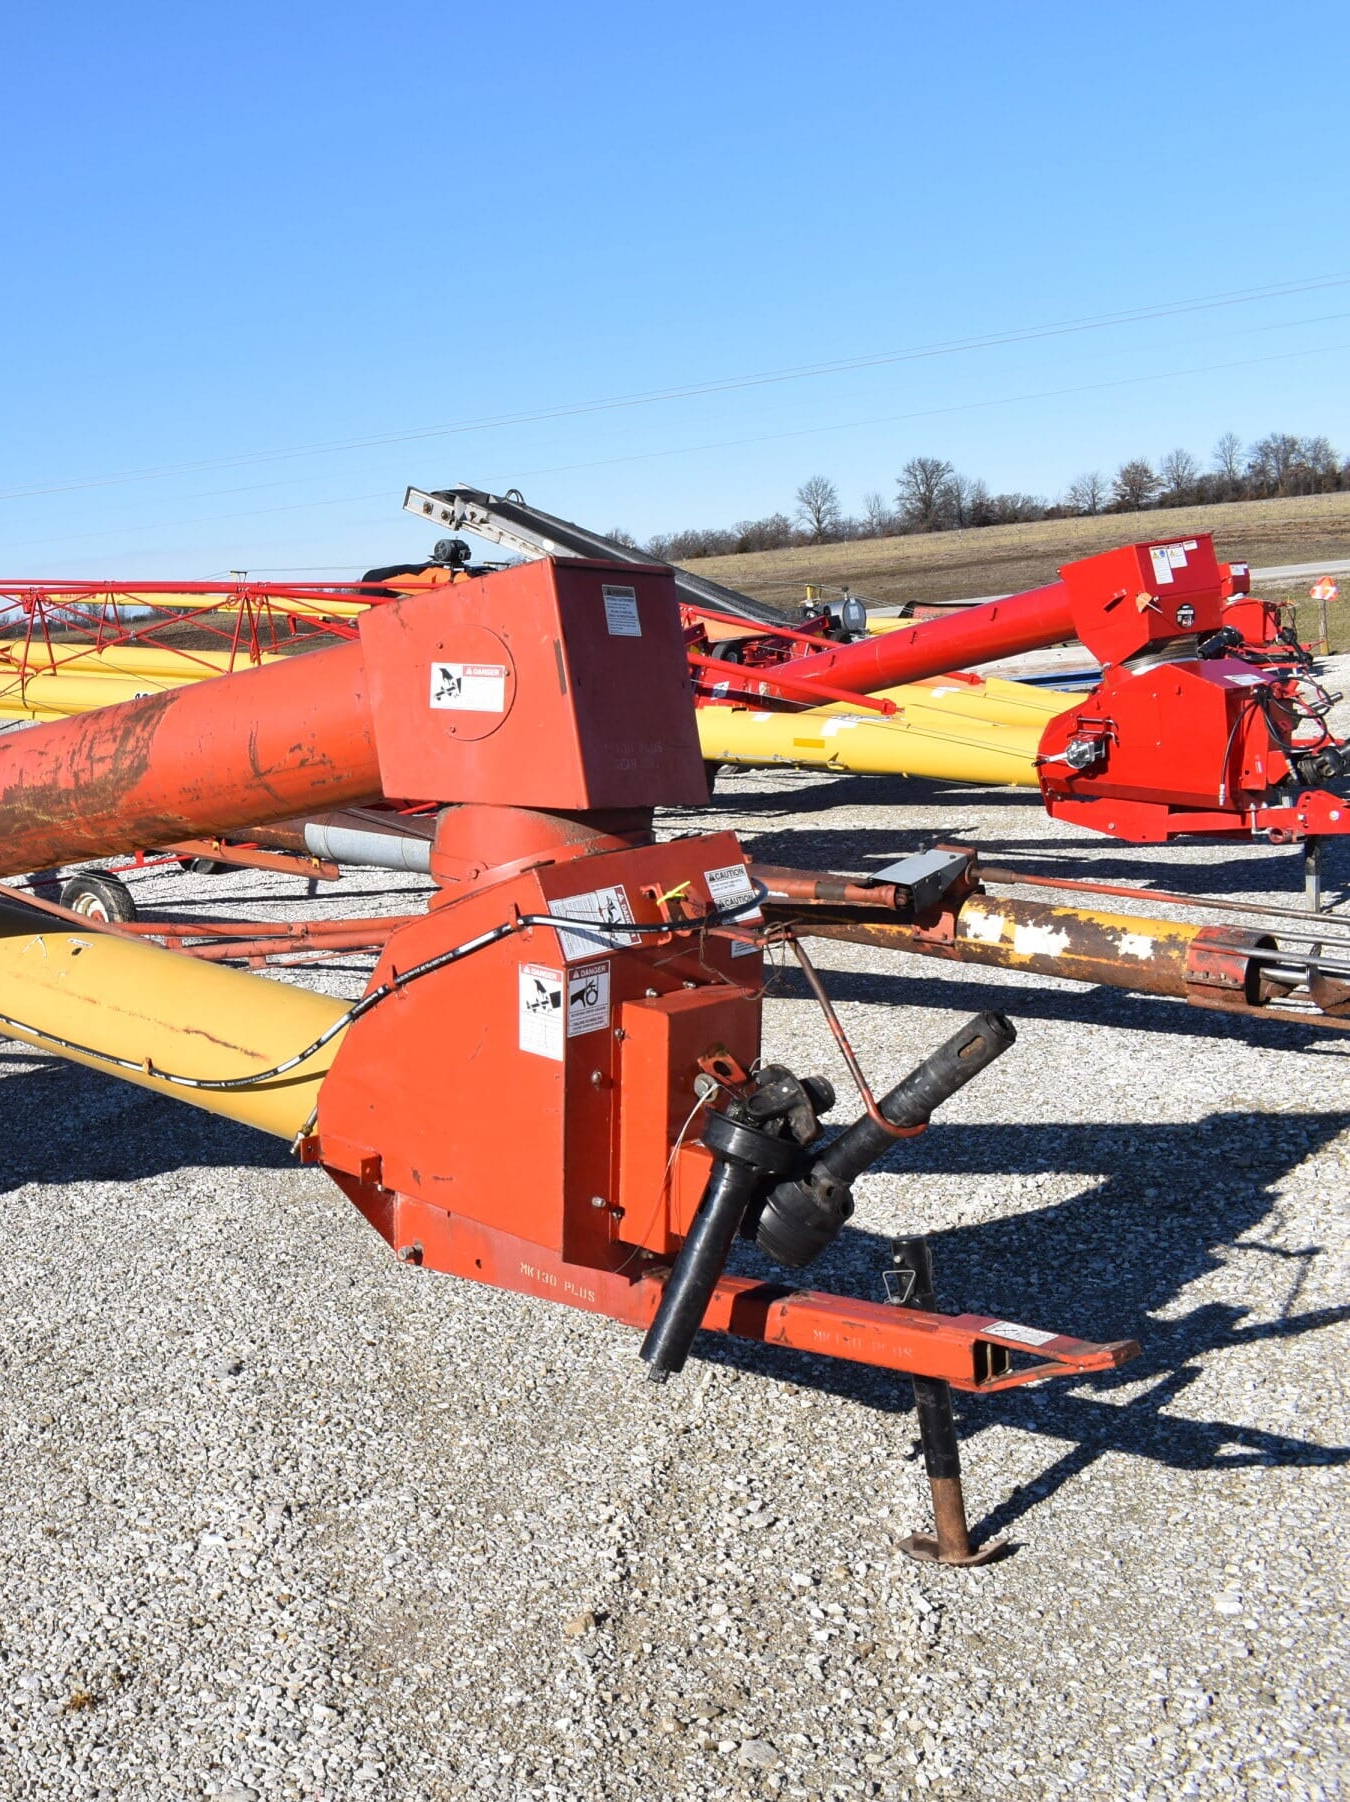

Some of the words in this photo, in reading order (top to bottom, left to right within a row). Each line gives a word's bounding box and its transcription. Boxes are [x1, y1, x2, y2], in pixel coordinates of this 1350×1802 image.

[714, 867, 745, 882] CAUTION
[725, 894, 754, 907] CAUTION
[530, 967, 557, 980] DANGER
[580, 965, 607, 977] DANGER
[520, 1262, 558, 1287] MK130
[563, 1280, 596, 1303] PLUS
